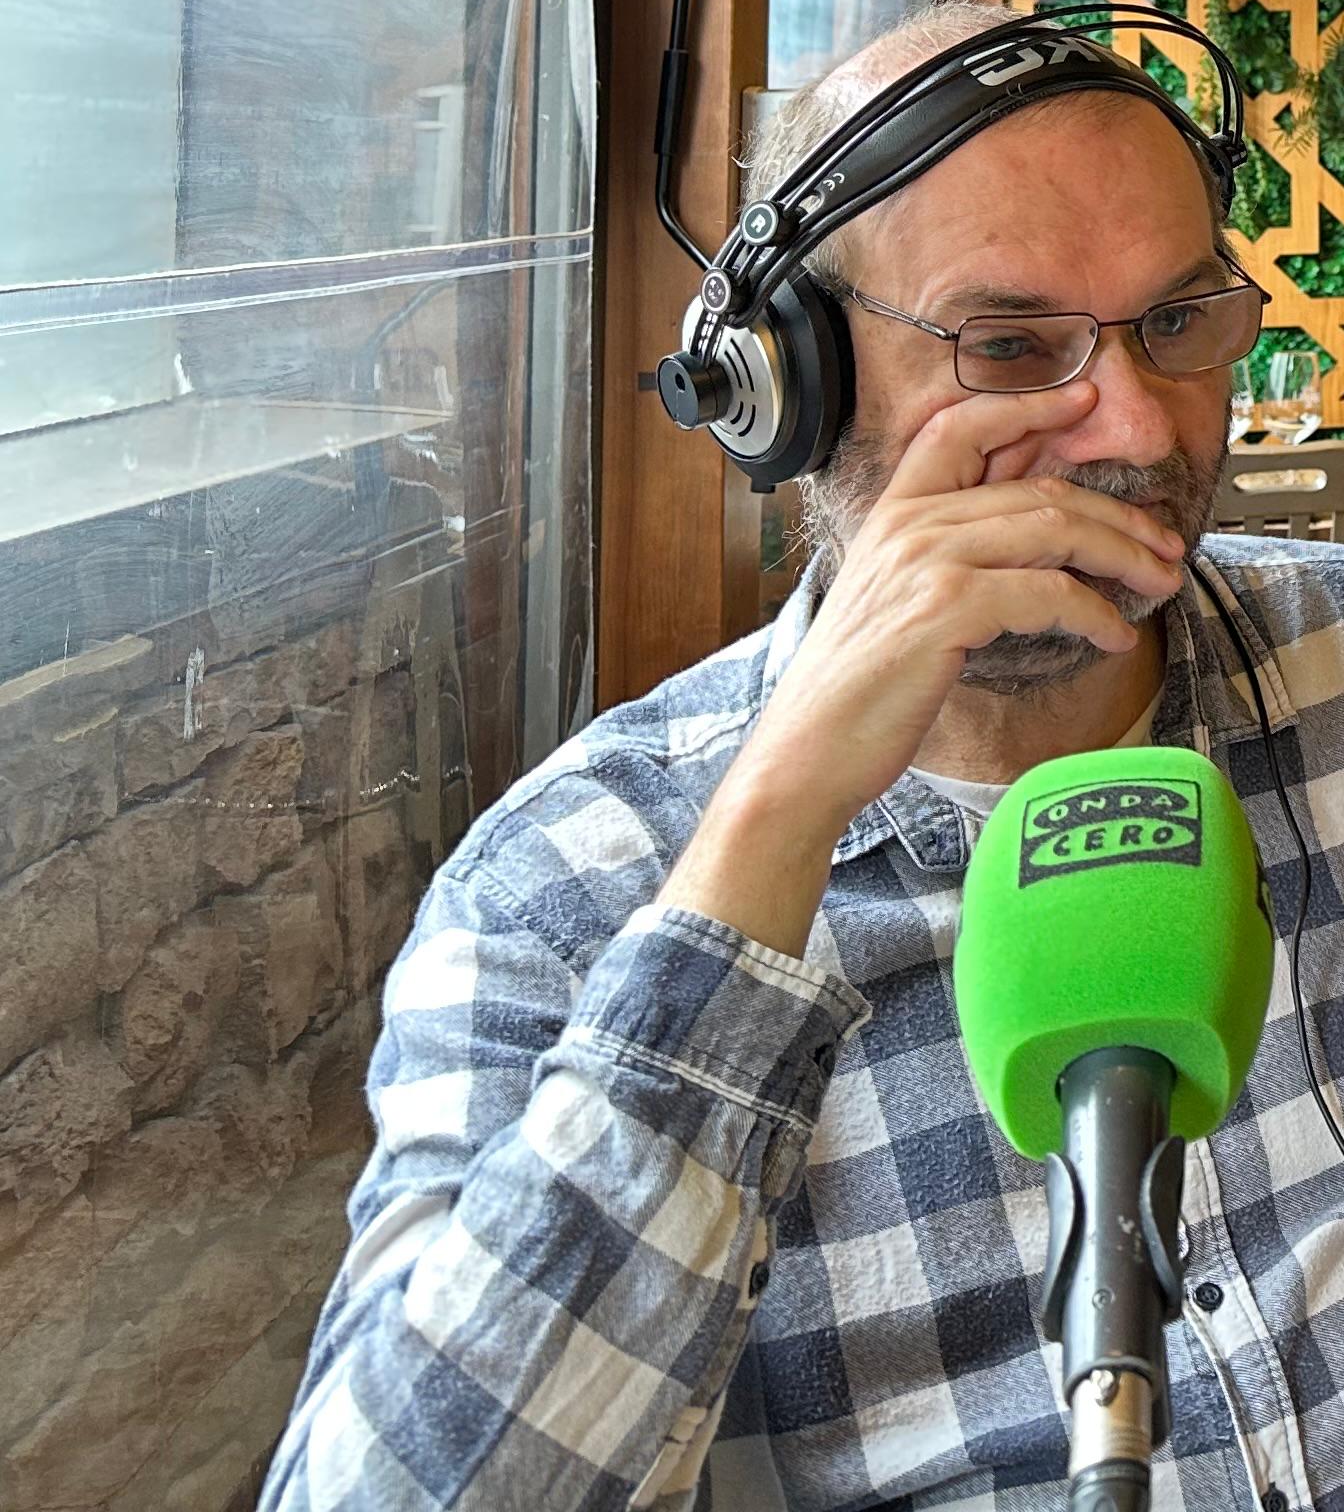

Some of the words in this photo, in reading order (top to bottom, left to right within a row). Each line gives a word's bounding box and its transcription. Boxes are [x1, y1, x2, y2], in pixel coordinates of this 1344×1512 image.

[750, 214, 767, 233] R
[1047, 792, 1174, 822] ONDA
[1052, 824, 1175, 857] CERO
